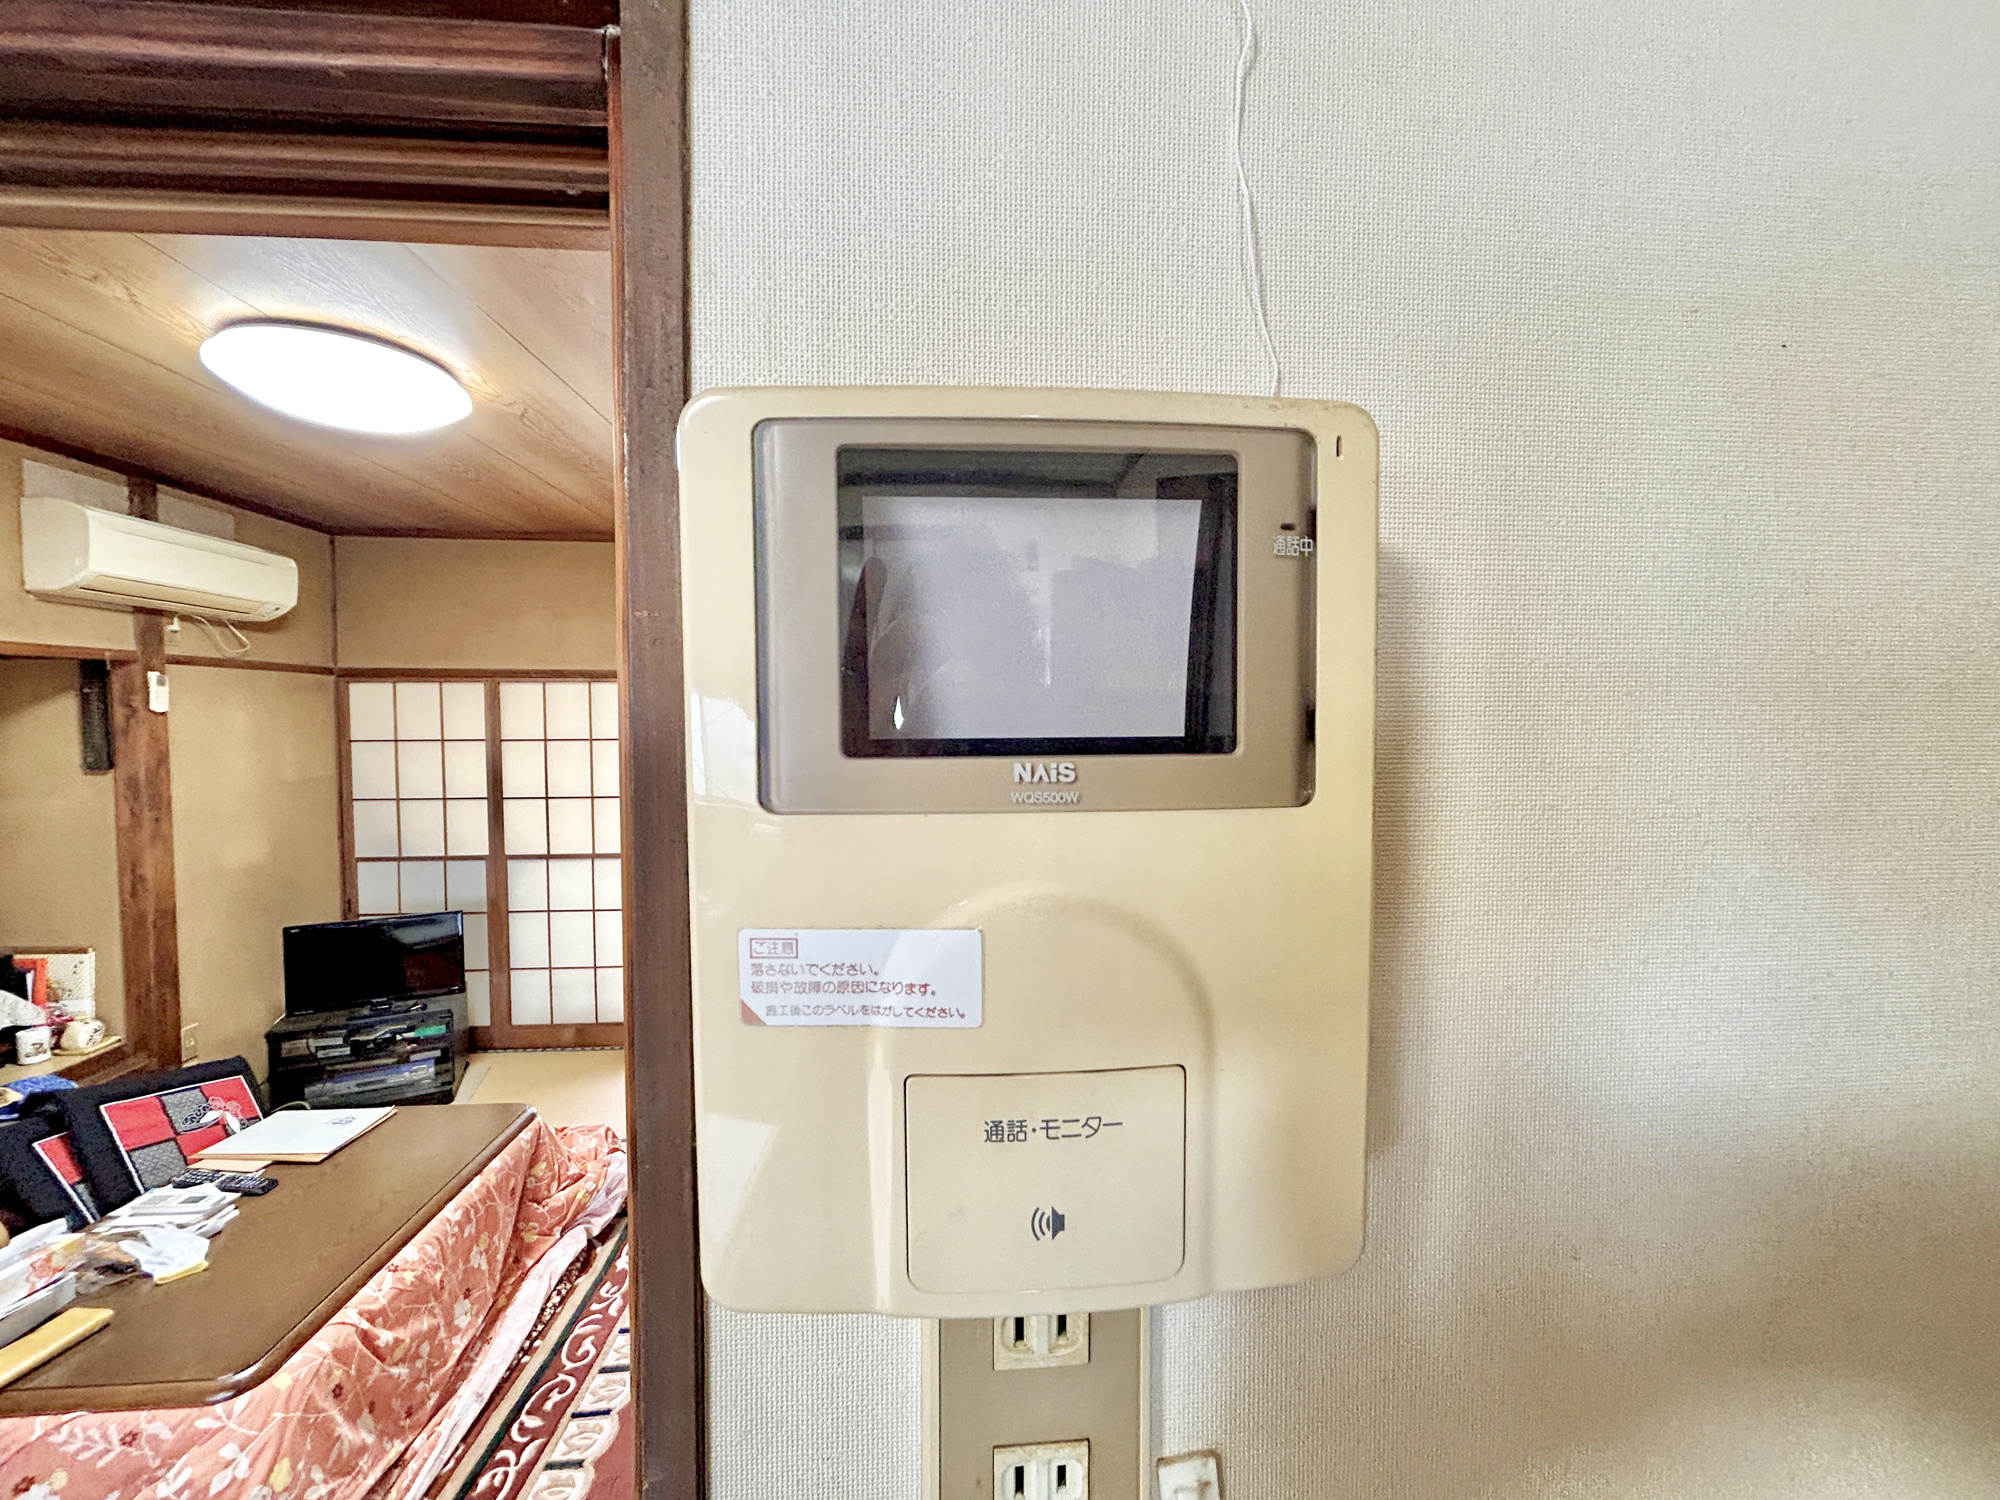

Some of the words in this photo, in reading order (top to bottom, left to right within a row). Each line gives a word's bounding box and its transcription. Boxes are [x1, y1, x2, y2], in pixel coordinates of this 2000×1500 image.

[1272, 535, 1313, 557] 通話中
[1010, 791, 1079, 804] WQS500W
[752, 941, 795, 956] ご注意
[750, 962, 880, 977] 落さないでください。
[750, 980, 938, 996] 破損や故障の原因になります。
[983, 1116, 1123, 1143] 通話・モニター
